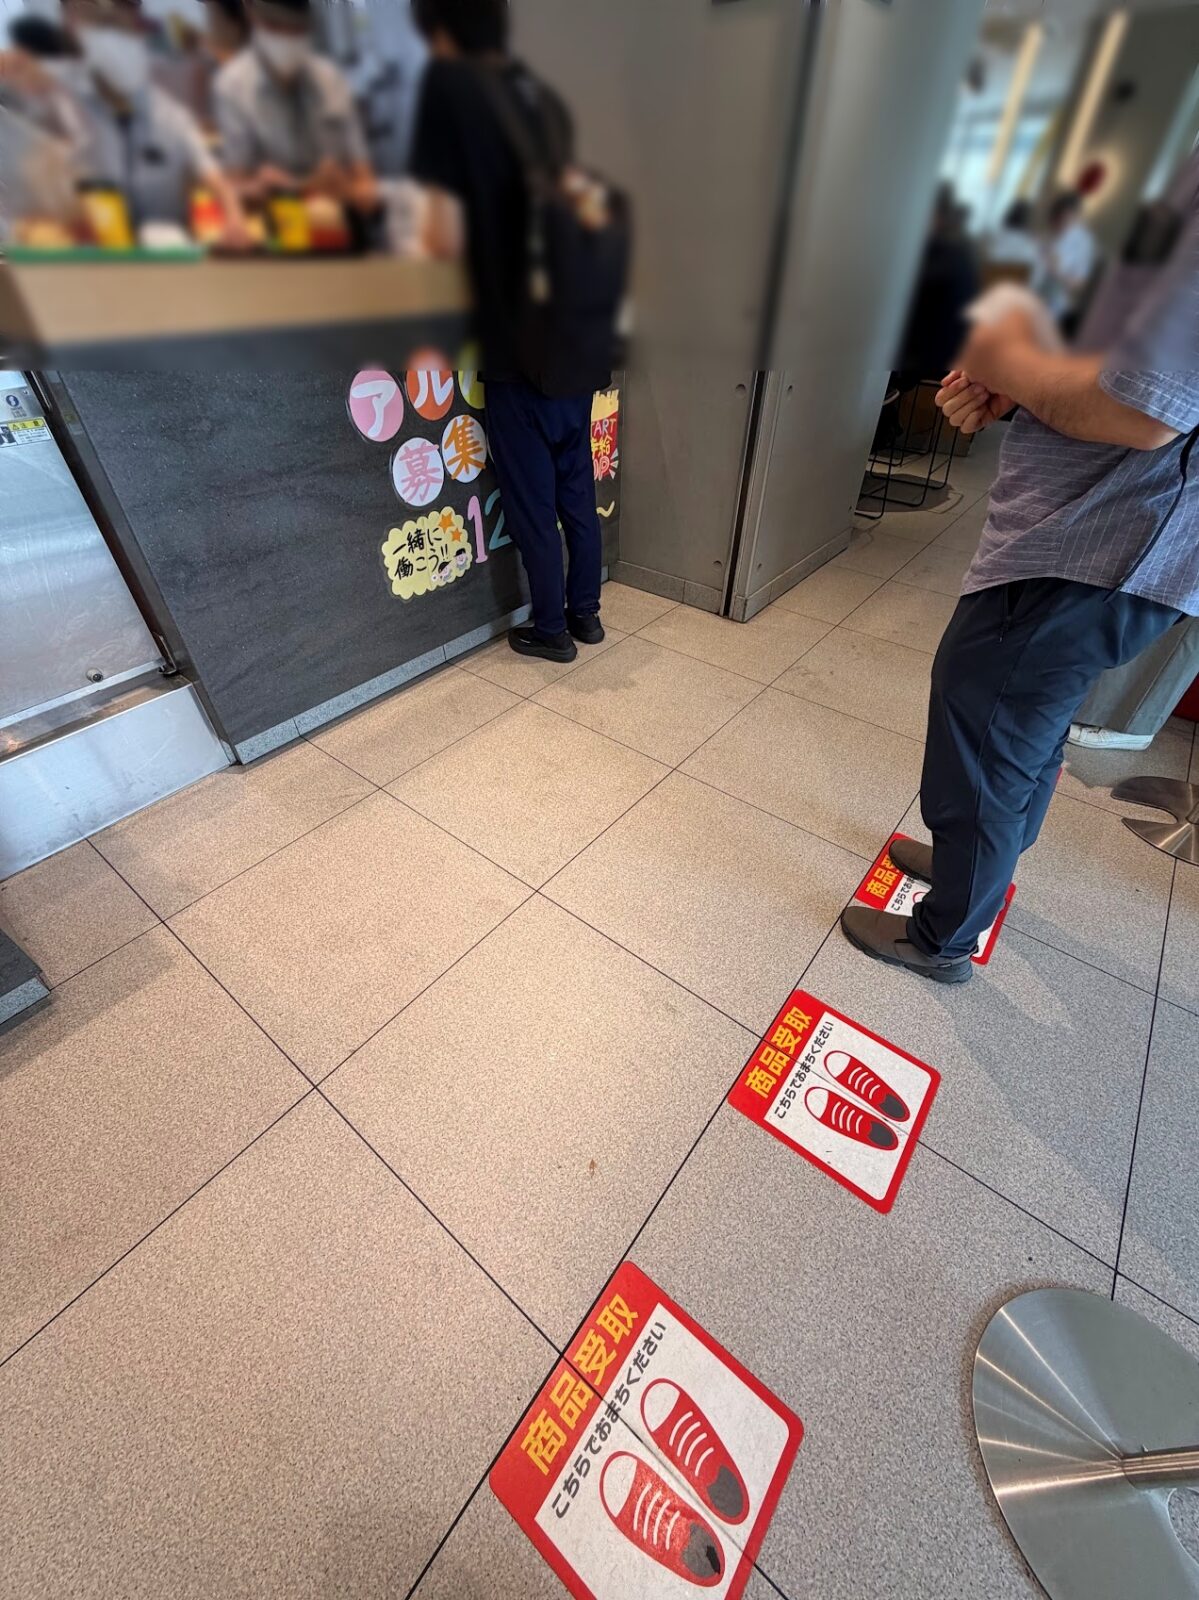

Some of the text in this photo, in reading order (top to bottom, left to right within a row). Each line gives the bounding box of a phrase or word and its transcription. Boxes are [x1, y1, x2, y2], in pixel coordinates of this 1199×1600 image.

[399, 415, 487, 503] 募集
[592, 418, 618, 437] ART
[393, 528, 442, 554] 一緒に
[745, 1006, 813, 1099] 商品受取
[774, 1021, 834, 1119] こちらでおまちください
[520, 1294, 638, 1476] 商品受取
[551, 1322, 667, 1519] こちらでおまちください
